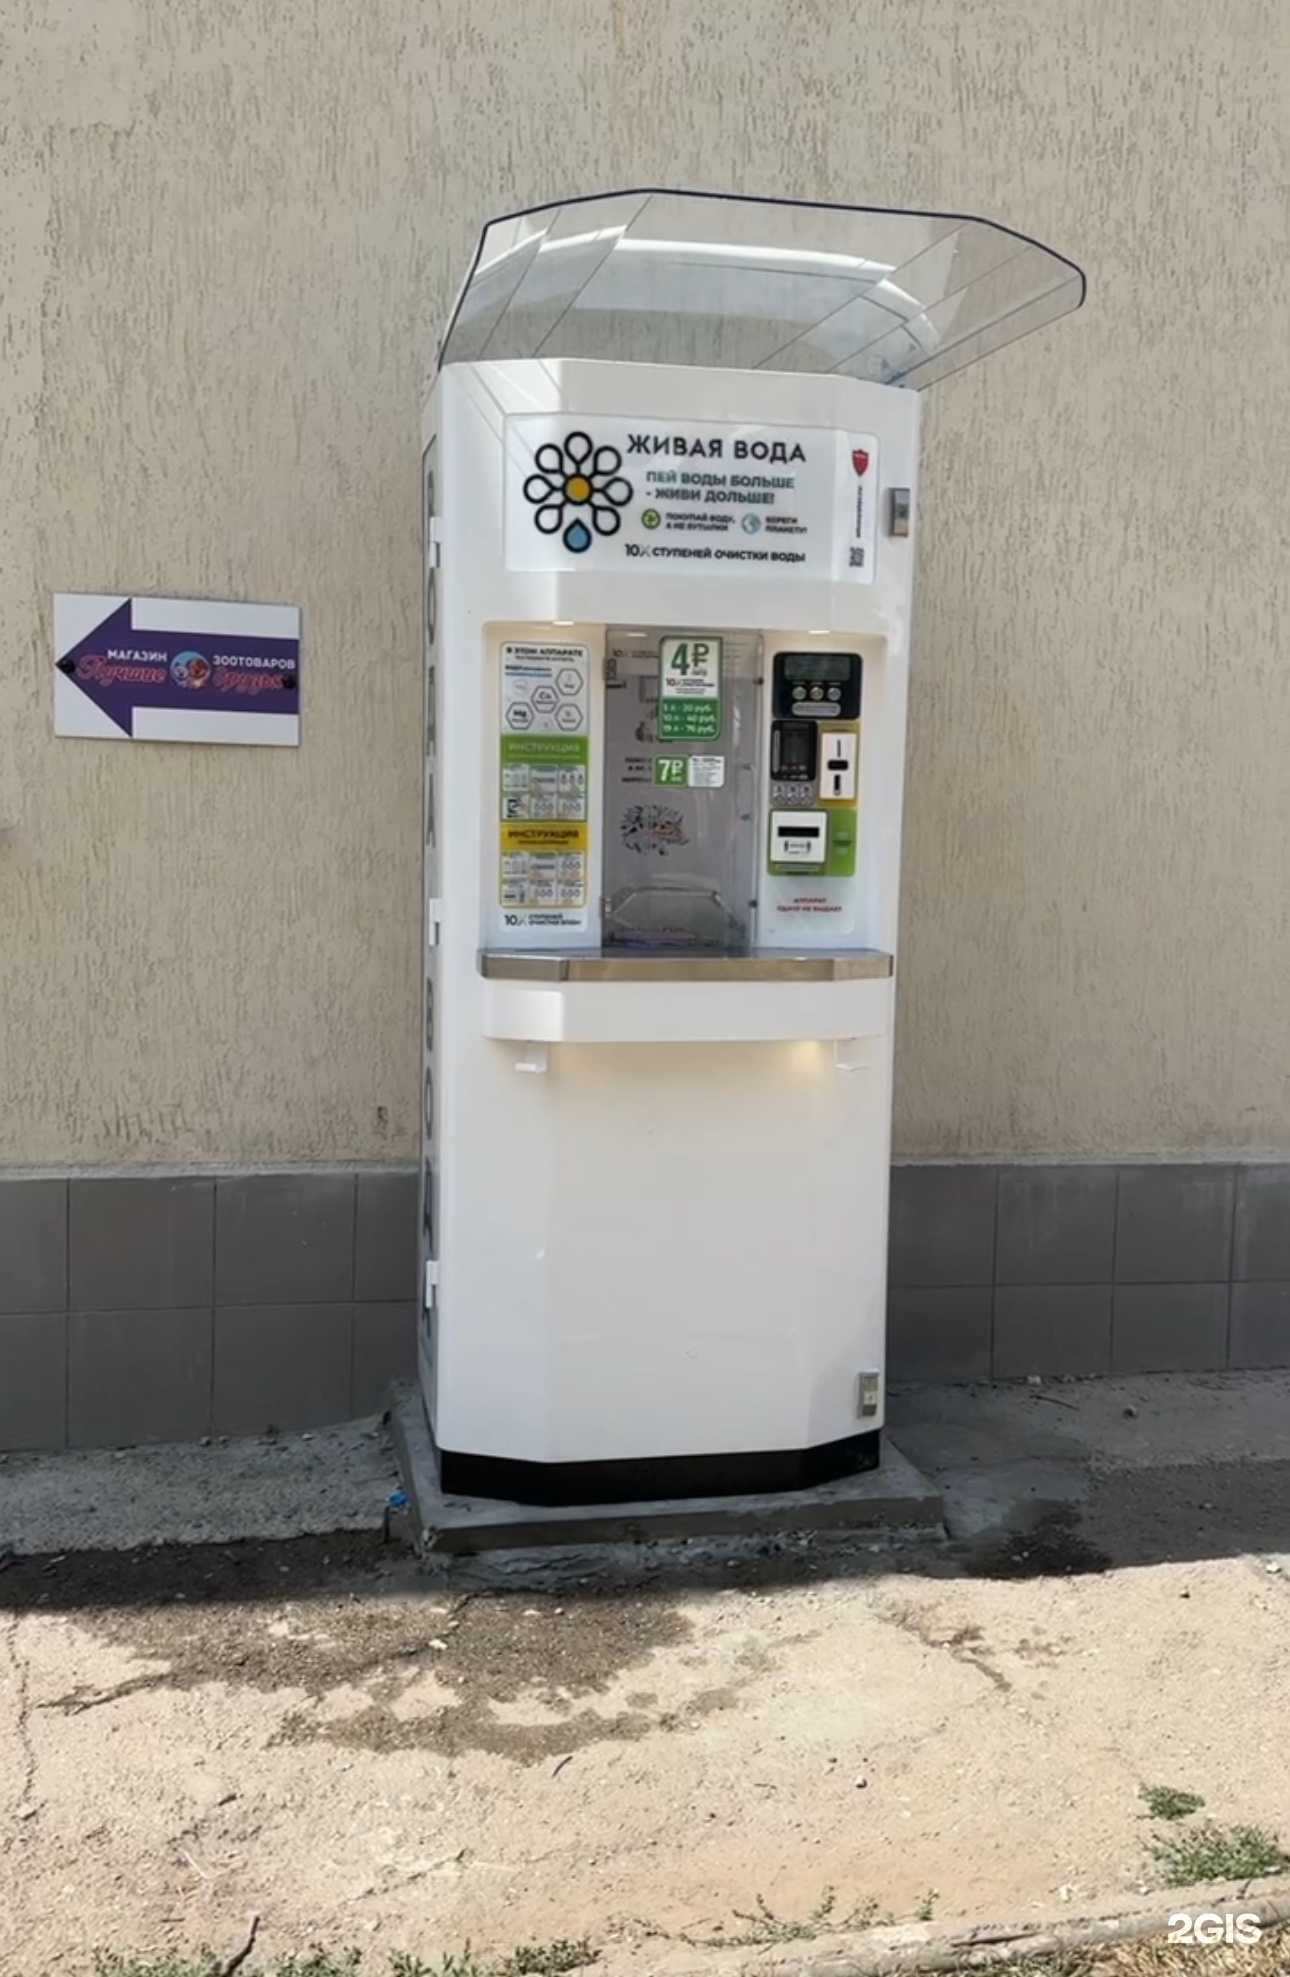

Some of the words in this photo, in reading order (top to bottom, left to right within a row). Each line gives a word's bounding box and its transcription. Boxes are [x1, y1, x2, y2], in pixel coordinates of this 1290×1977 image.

[626, 433, 723, 458] ЖИВАЯ
[733, 440, 807, 464] ВОДА
[646, 470, 677, 483] ПЕЙ
[680, 472, 726, 486] ВОДЫ
[730, 475, 795, 489] БОЛЬШЕ
[655, 488, 701, 500] ЖИВИ
[704, 490, 776, 505] ДОЛЬШЕ!
[665, 512, 708, 522] ПОКУПАЙ
[652, 547, 712, 559] СТУПЕНЕЙ
[714, 549, 768, 561] ОЧИСТКИ
[770, 552, 806, 563] ВОДЫ
[107, 649, 168, 662] МАГАЗИН
[212, 655, 296, 670] ЗООТОВАРОВ
